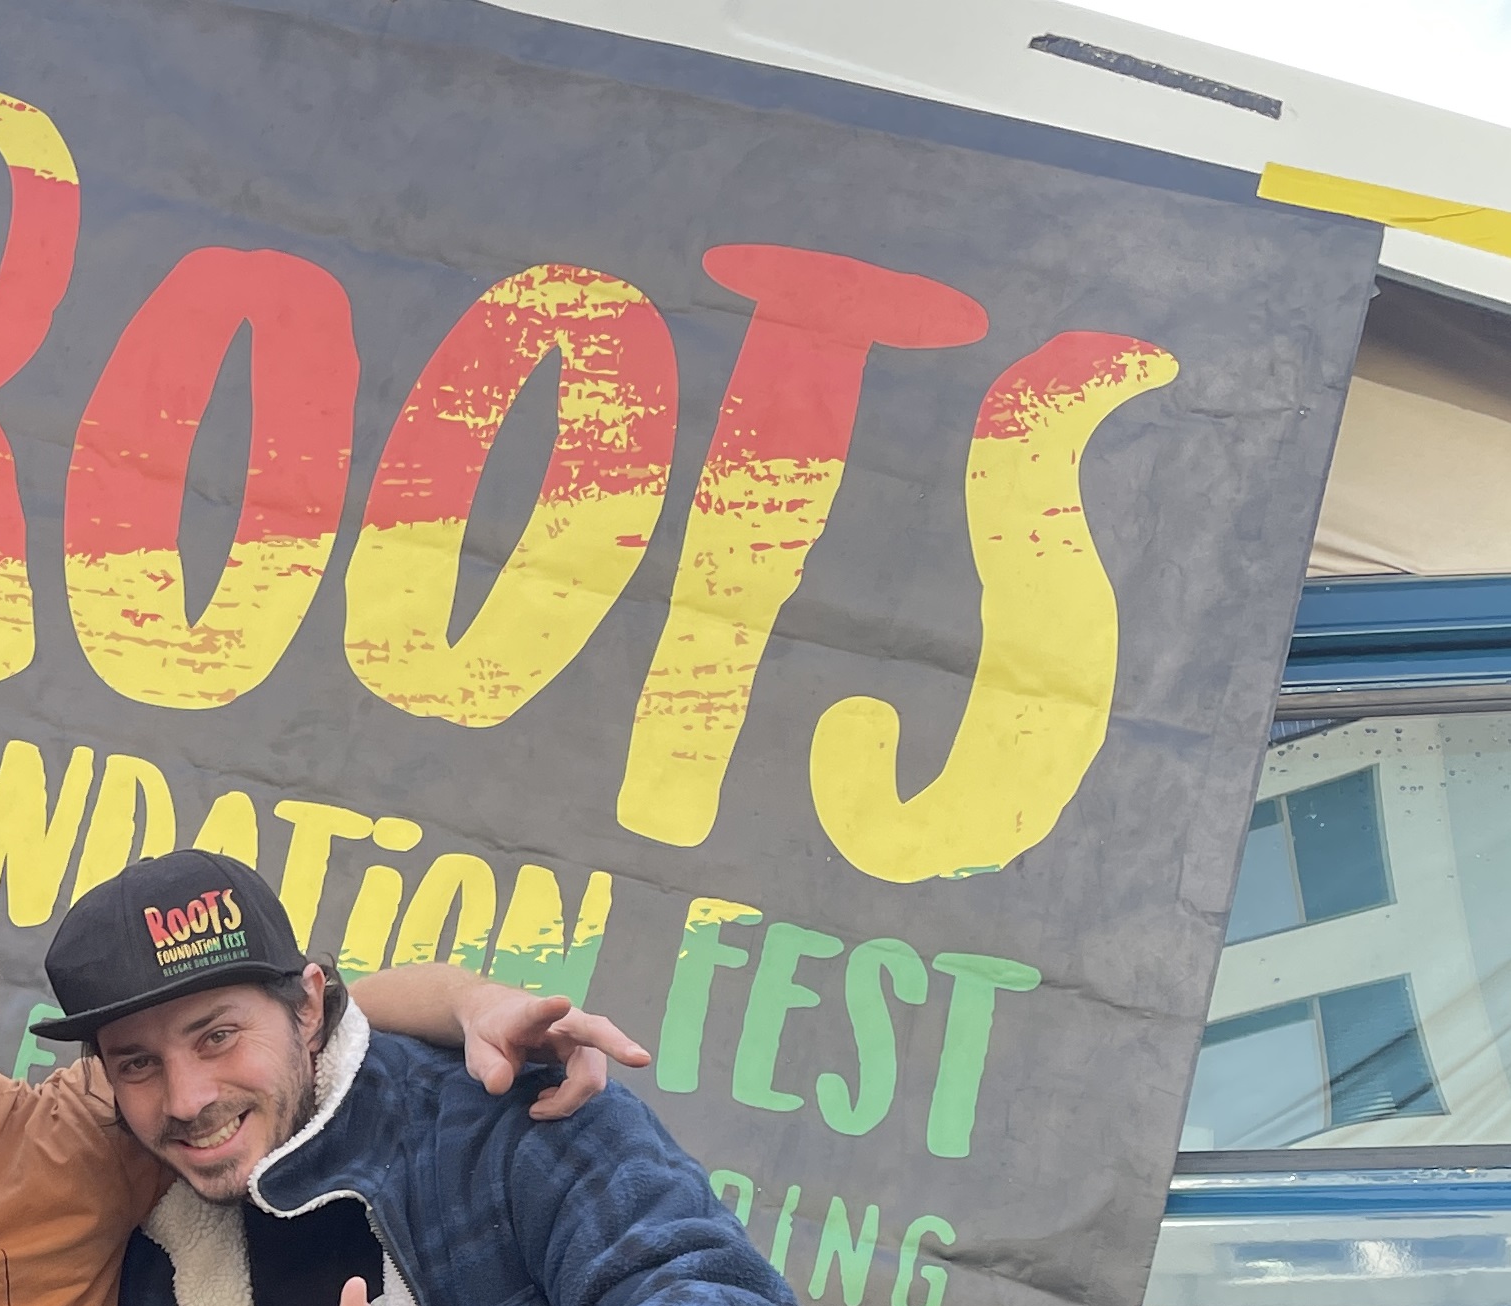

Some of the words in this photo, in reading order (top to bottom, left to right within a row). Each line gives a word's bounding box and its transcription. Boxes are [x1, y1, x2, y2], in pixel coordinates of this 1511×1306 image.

[144, 889, 242, 949] ROOTS
[223, 931, 246, 950] FEST
[656, 897, 1042, 1158] FEST
